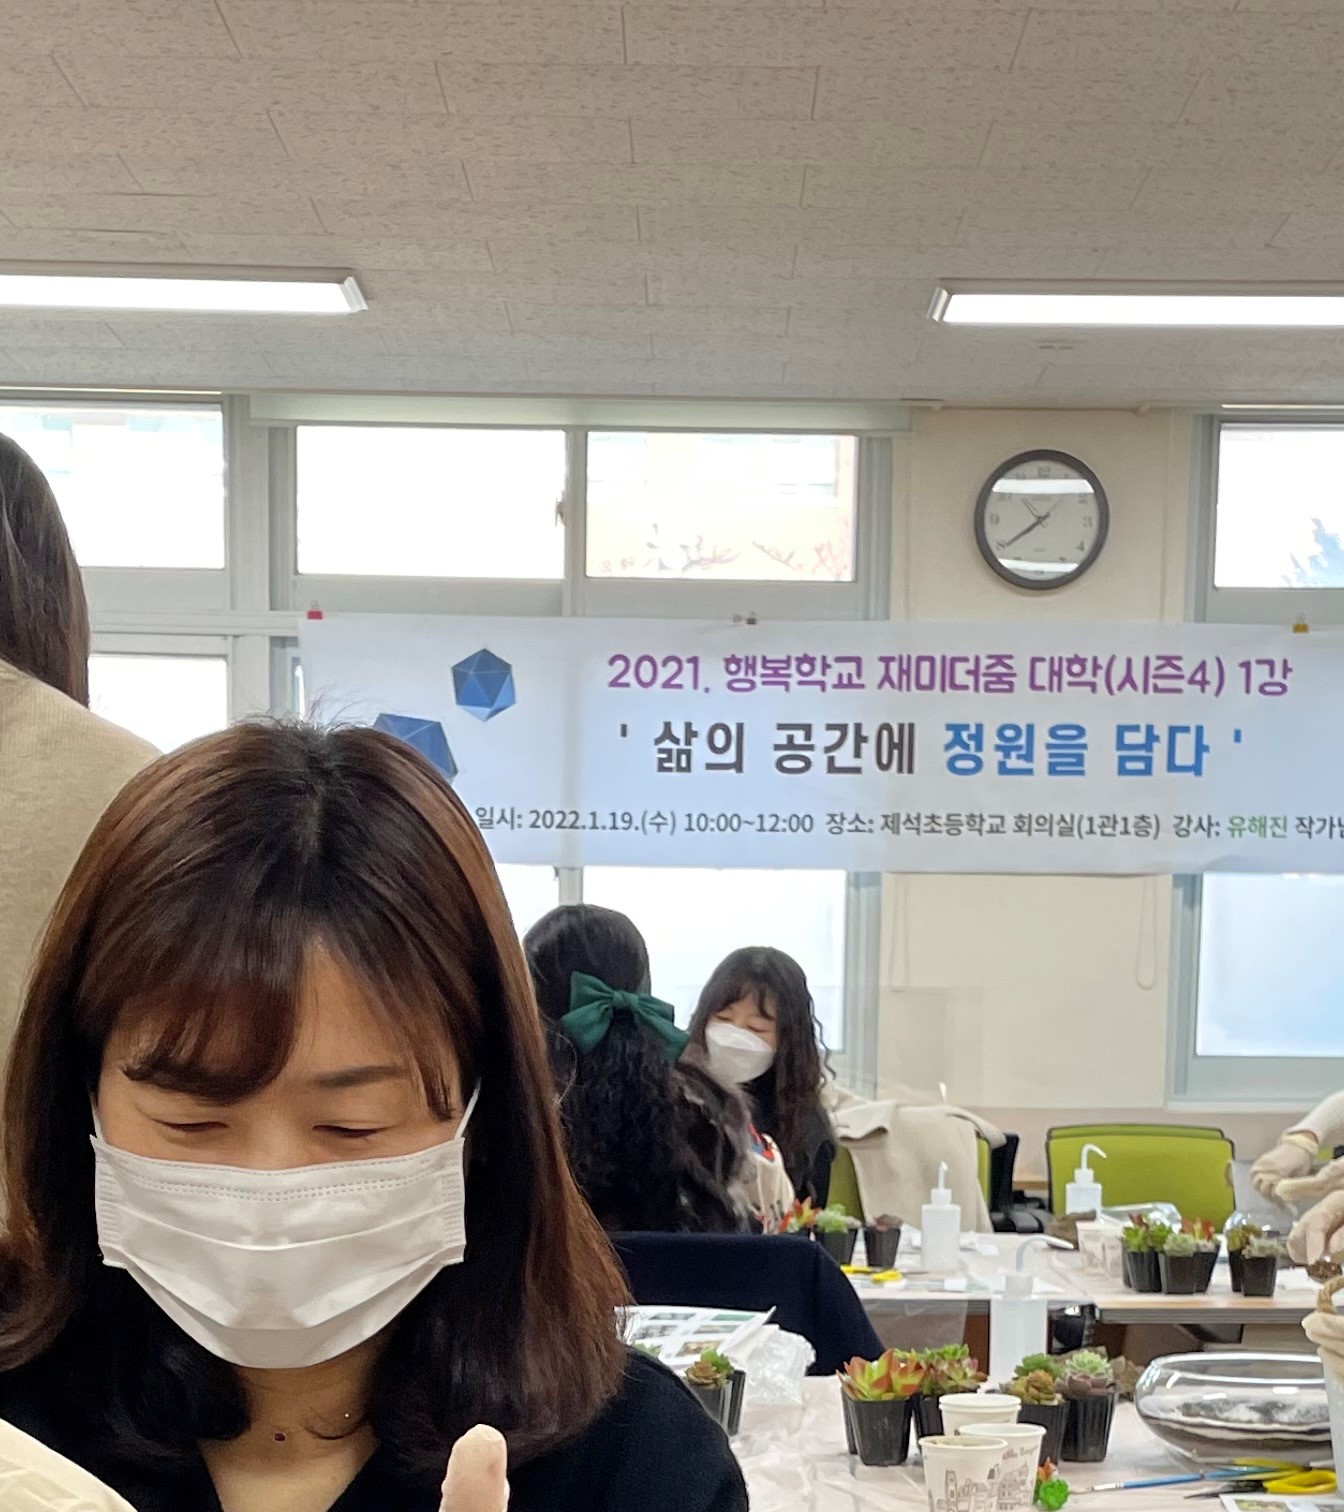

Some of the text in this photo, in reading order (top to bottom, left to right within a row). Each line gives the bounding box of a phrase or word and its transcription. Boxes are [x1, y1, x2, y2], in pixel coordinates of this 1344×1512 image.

[607, 653, 1294, 698] 2021. 행복학교 재미더줌 대학(시즌4) 1강
[654, 721, 1211, 778] 삶의 공간에 정원을 담다
[475, 806, 523, 830] 일시:
[528, 809, 677, 836] 2022.1.19.(수)
[684, 812, 815, 834] 10:00~12:00
[825, 813, 875, 836] 장소:
[880, 813, 1007, 837] 제석초등학교
[1012, 813, 1161, 840] 회의실(1관1층)
[1172, 813, 1221, 838] 강사:
[1226, 814, 1289, 839] 유해진
